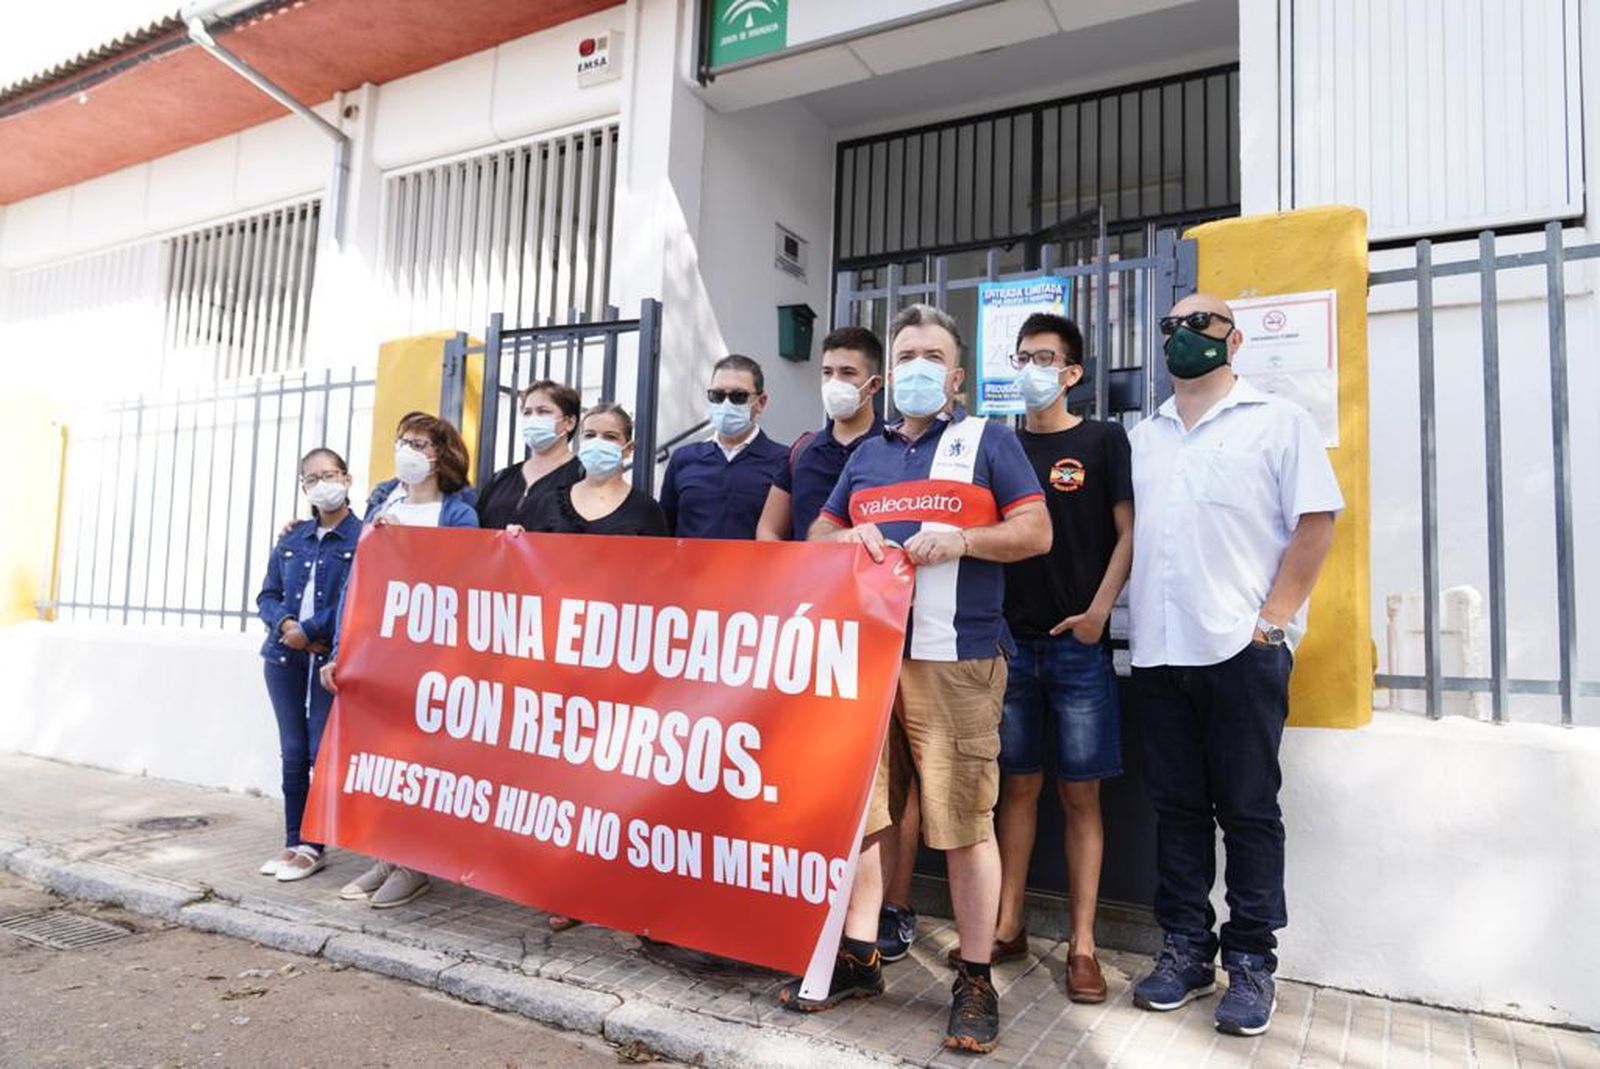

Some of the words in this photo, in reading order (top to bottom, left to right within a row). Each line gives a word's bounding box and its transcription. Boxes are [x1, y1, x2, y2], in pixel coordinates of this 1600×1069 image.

[984, 287, 1022, 300] ENTRADA
[1023, 284, 1063, 298] LIMITADA
[859, 494, 962, 516] valecuatro
[379, 580, 459, 647] POR
[467, 588, 545, 661] UNA
[554, 597, 859, 700] EDUCACIÓN
[415, 670, 504, 746] CON
[508, 686, 778, 802] RECURSOS.
[343, 752, 493, 823] ¡NUESTROS
[493, 784, 576, 848] HIJOS
[575, 804, 621, 861] NO
[627, 819, 702, 879] SON
[713, 835, 849, 907] MENOS
